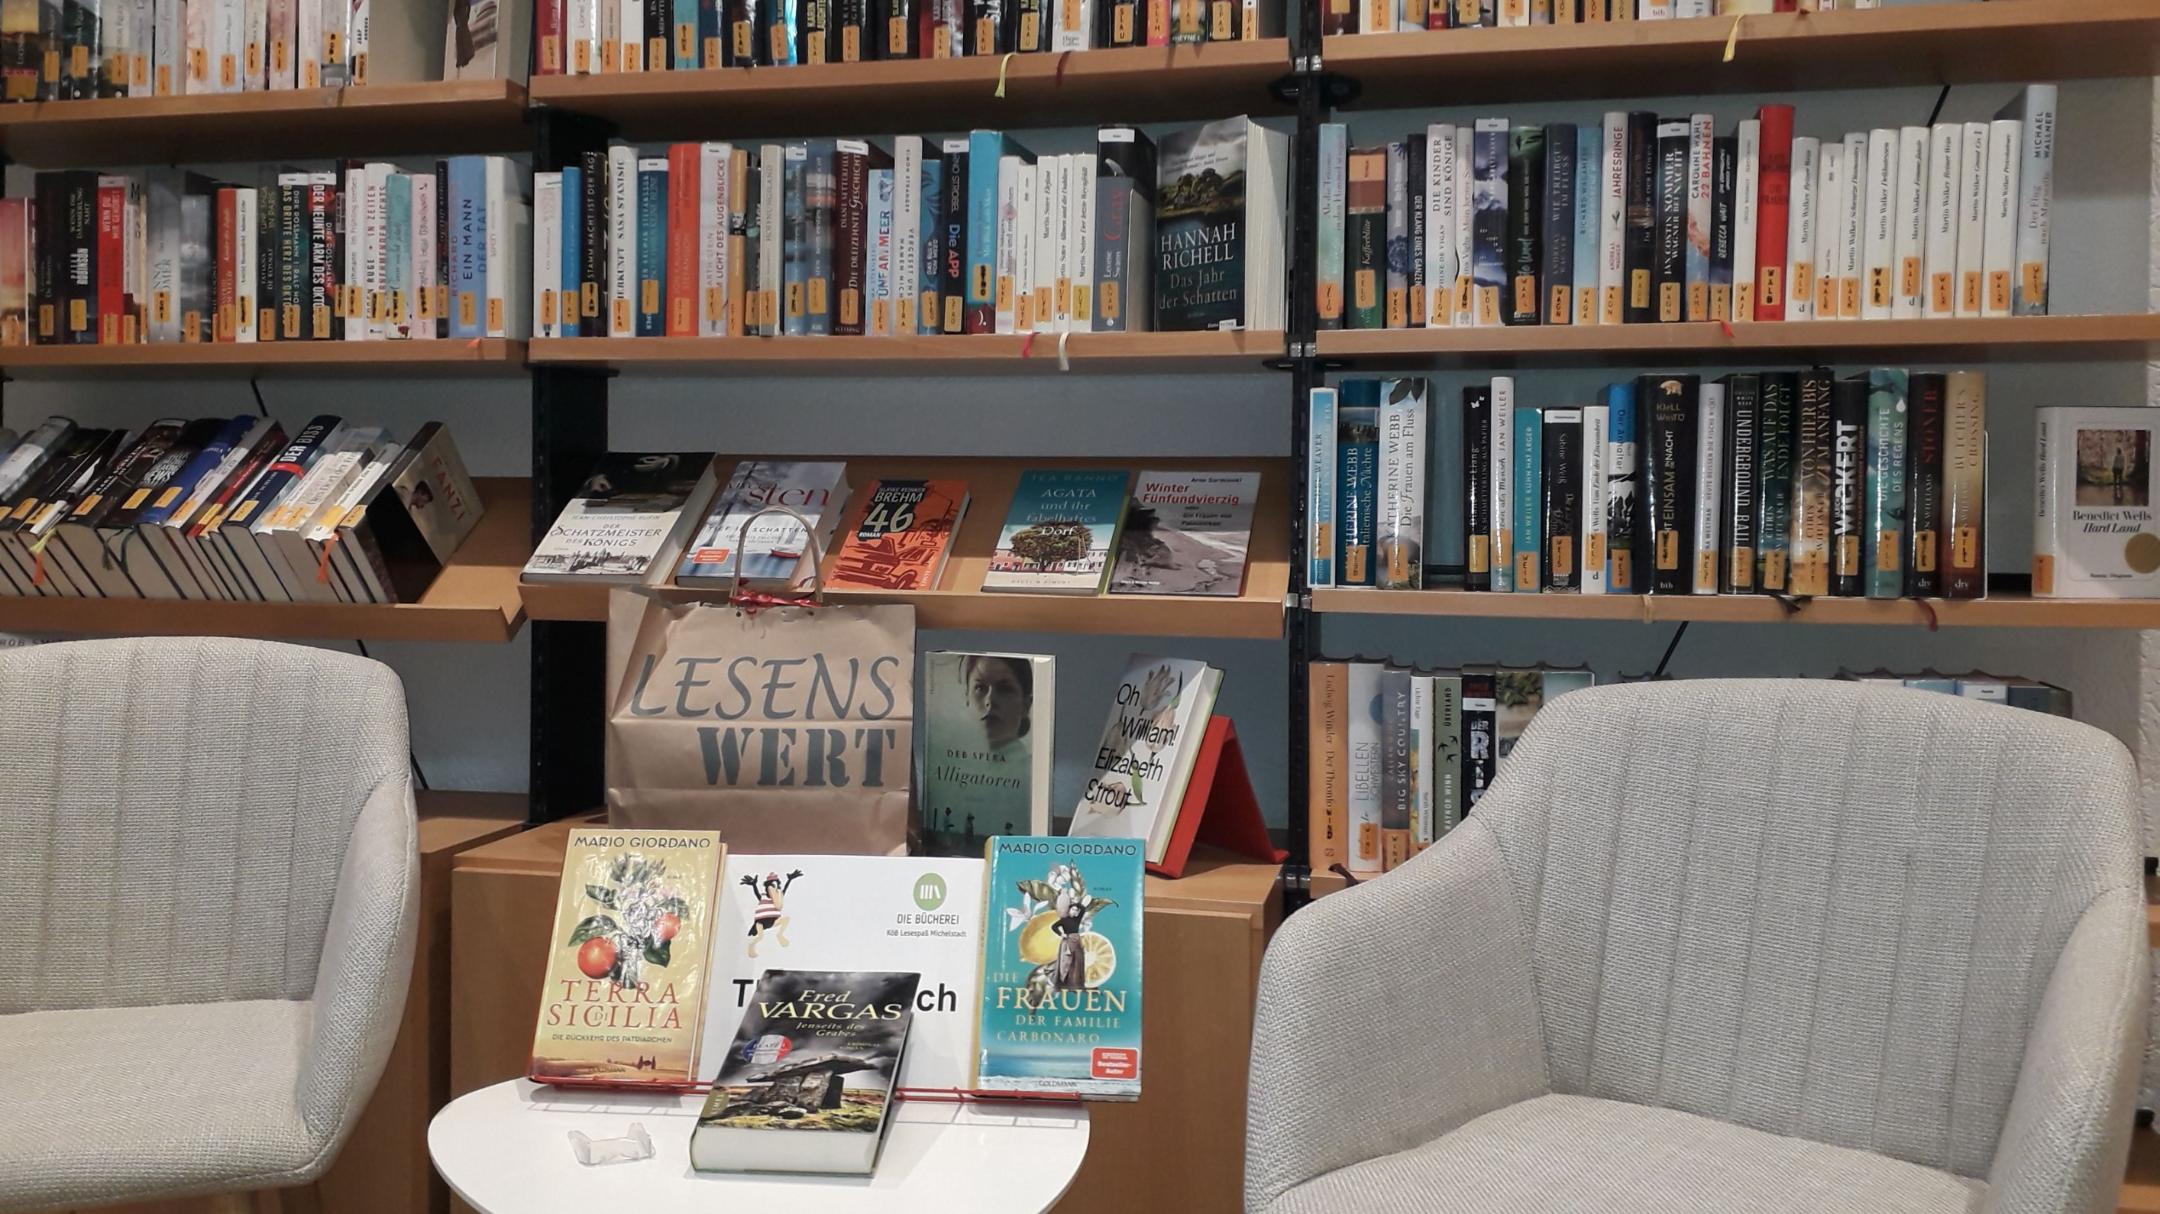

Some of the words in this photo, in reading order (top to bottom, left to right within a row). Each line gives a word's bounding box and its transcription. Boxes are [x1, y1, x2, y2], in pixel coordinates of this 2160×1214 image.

[1692, 121, 1701, 147] WAHL
[2033, 112, 2043, 158] MICHAEL
[2043, 112, 2053, 159] WALLNER
[1433, 139, 1441, 186] KINDER
[1443, 135, 1452, 182] KÖNIGE
[1612, 126, 1623, 199] JAHRESRINGE
[1702, 121, 1711, 178] BAHNEN
[1552, 141, 1561, 194] TREIBGUT
[1673, 148, 1683, 193] NACHT
[1692, 150, 1700, 199] CAROLINE
[283, 185, 291, 201] DAS
[313, 185, 323, 203] DER
[717, 159, 725, 226] AUGENBLICKS
[1664, 152, 1673, 212] SOMMER
[1702, 182, 1710, 199] 22
[1943, 180, 1951, 206] Walker
[367, 185, 375, 220] ZEITEN
[1414, 195, 1422, 210] DER
[1433, 191, 1441, 212] DIE
[1444, 187, 1452, 216] SIND
[1552, 199, 1560, 221] WIE
[1562, 197, 1569, 207] IM
[1880, 189, 1888, 214] Walker
[1912, 189, 1920, 214] Walker
[283, 205, 291, 236] DRITTE
[313, 206, 324, 239] NEUNTE
[463, 199, 472, 245] MANN
[478, 205, 486, 232] TAT
[1414, 212, 1422, 234] KLANG
[1879, 215, 1887, 240] Martin
[1942, 208, 1950, 233] Martin
[948, 224, 960, 247] Die
[1161, 223, 1236, 252] HANNAH
[1362, 219, 1372, 265] Kaffeeblüte
[1664, 216, 1672, 252] COSTIN
[1718, 224, 1727, 258] REBECCA
[1848, 220, 1856, 245] Walker
[283, 239, 291, 261] HERZ
[313, 242, 324, 263] ARM
[478, 245, 486, 273] DER
[1163, 243, 1234, 270] RICHELL
[1847, 247, 1855, 271] Martin
[283, 265, 291, 281] DES
[313, 267, 324, 284] DES
[463, 254, 472, 280] EIN
[948, 249, 959, 279] APP
[1664, 257, 1672, 275] JAN
[1170, 272, 1193, 289] Das
[1198, 267, 1225, 286] Jahr
[1160, 294, 1178, 310] der
[1183, 287, 1237, 306] Schatten
[1764, 384, 1777, 411] DAS
[1803, 379, 1816, 402] BIS
[1617, 409, 1625, 427] Der
[1779, 384, 1791, 433] FOLGT
[1818, 380, 1830, 443] ANFANG
[1389, 414, 1400, 453] WEBB
[1403, 408, 1414, 437] Fluss
[1763, 418, 1776, 446] AUF
[1802, 406, 1816, 443] HIER
[1923, 388, 1937, 464] STONER
[1969, 394, 1979, 467] CROSSING
[280, 446, 307, 463] DER
[296, 425, 324, 443] BISS
[1314, 433, 1323, 473] WEAVER
[1406, 442, 1414, 459] am
[1616, 429, 1625, 471] Anhalter
[1665, 430, 1673, 460] NACHT
[1879, 408, 1890, 479] GESCHICHTE
[1894, 421, 1903, 466] REGENS
[1347, 447, 1358, 487] WEBB
[1361, 447, 1372, 488] Nächte
[1736, 410, 1753, 506] UNDERGROUND
[1763, 451, 1776, 480] WAS
[1802, 447, 1814, 480] VON
[1146, 483, 1190, 492] Winter
[1401, 461, 1414, 504] Frauen
[1834, 420, 1858, 535] WICKERT
[1893, 470, 1902, 492] DES
[749, 483, 831, 506] sten
[875, 492, 923, 502] BREHM
[1040, 489, 1097, 497] AGATA
[1041, 501, 1067, 510] und
[1072, 501, 1091, 510] ihr
[1143, 493, 1240, 506] Fünfundvierzig
[1387, 458, 1400, 538] KATHERINE
[1664, 471, 1675, 520] EINSAM
[864, 502, 915, 533] 46
[1401, 507, 1412, 527] Die
[2073, 510, 2120, 520] Benedict
[2123, 511, 2152, 520] Wells
[2083, 523, 2111, 533] Hard
[2112, 523, 2142, 532] Land
[550, 525, 662, 537] SCHATZMEISTER
[583, 538, 638, 546] KÖNIGS
[1041, 526, 1078, 536] Dorf
[630, 653, 900, 720] LESENS
[1117, 683, 1141, 706] Oh
[1443, 687, 1452, 727] ÜBERLAND
[1121, 715, 1179, 747] William!
[1324, 710, 1335, 744] Winder
[697, 727, 896, 787] WERT
[946, 749, 969, 759] DEB
[973, 751, 1006, 763] SPERA
[1095, 747, 1164, 782] Elizabeth
[935, 765, 1023, 789] Alligatoren
[1355, 742, 1370, 801] LIBELLEN
[1397, 761, 1406, 784] SKY
[1444, 774, 1452, 795] WINN
[1085, 778, 1132, 810] Strout
[1397, 789, 1407, 810] BIG
[574, 837, 624, 848] MARIO
[630, 837, 711, 849] GIORDANO
[999, 843, 1049, 855] MARIO
[1054, 843, 1137, 856] GIORDANO
[897, 913, 912, 924] DIE
[915, 912, 960, 925] BÜCHEREI
[899, 929, 929, 937] Lesespaß
[930, 929, 967, 938] Michelstadt
[993, 971, 1019, 983] DIE
[560, 980, 680, 1004] TERRA
[797, 990, 852, 1003] Fred
[996, 987, 1127, 1013] FRAUEN
[546, 1004, 683, 1030] SICILIA
[758, 1002, 903, 1020] VARGAS
[1015, 1014, 1046, 1026] DER
[1055, 1016, 1121, 1029] FAMILIE
[552, 1033, 564, 1041] DIE
[566, 1033, 605, 1042] RÜCKKEHR
[796, 1022, 842, 1030] Jenseits
[996, 1030, 1100, 1043] CARBONARO
